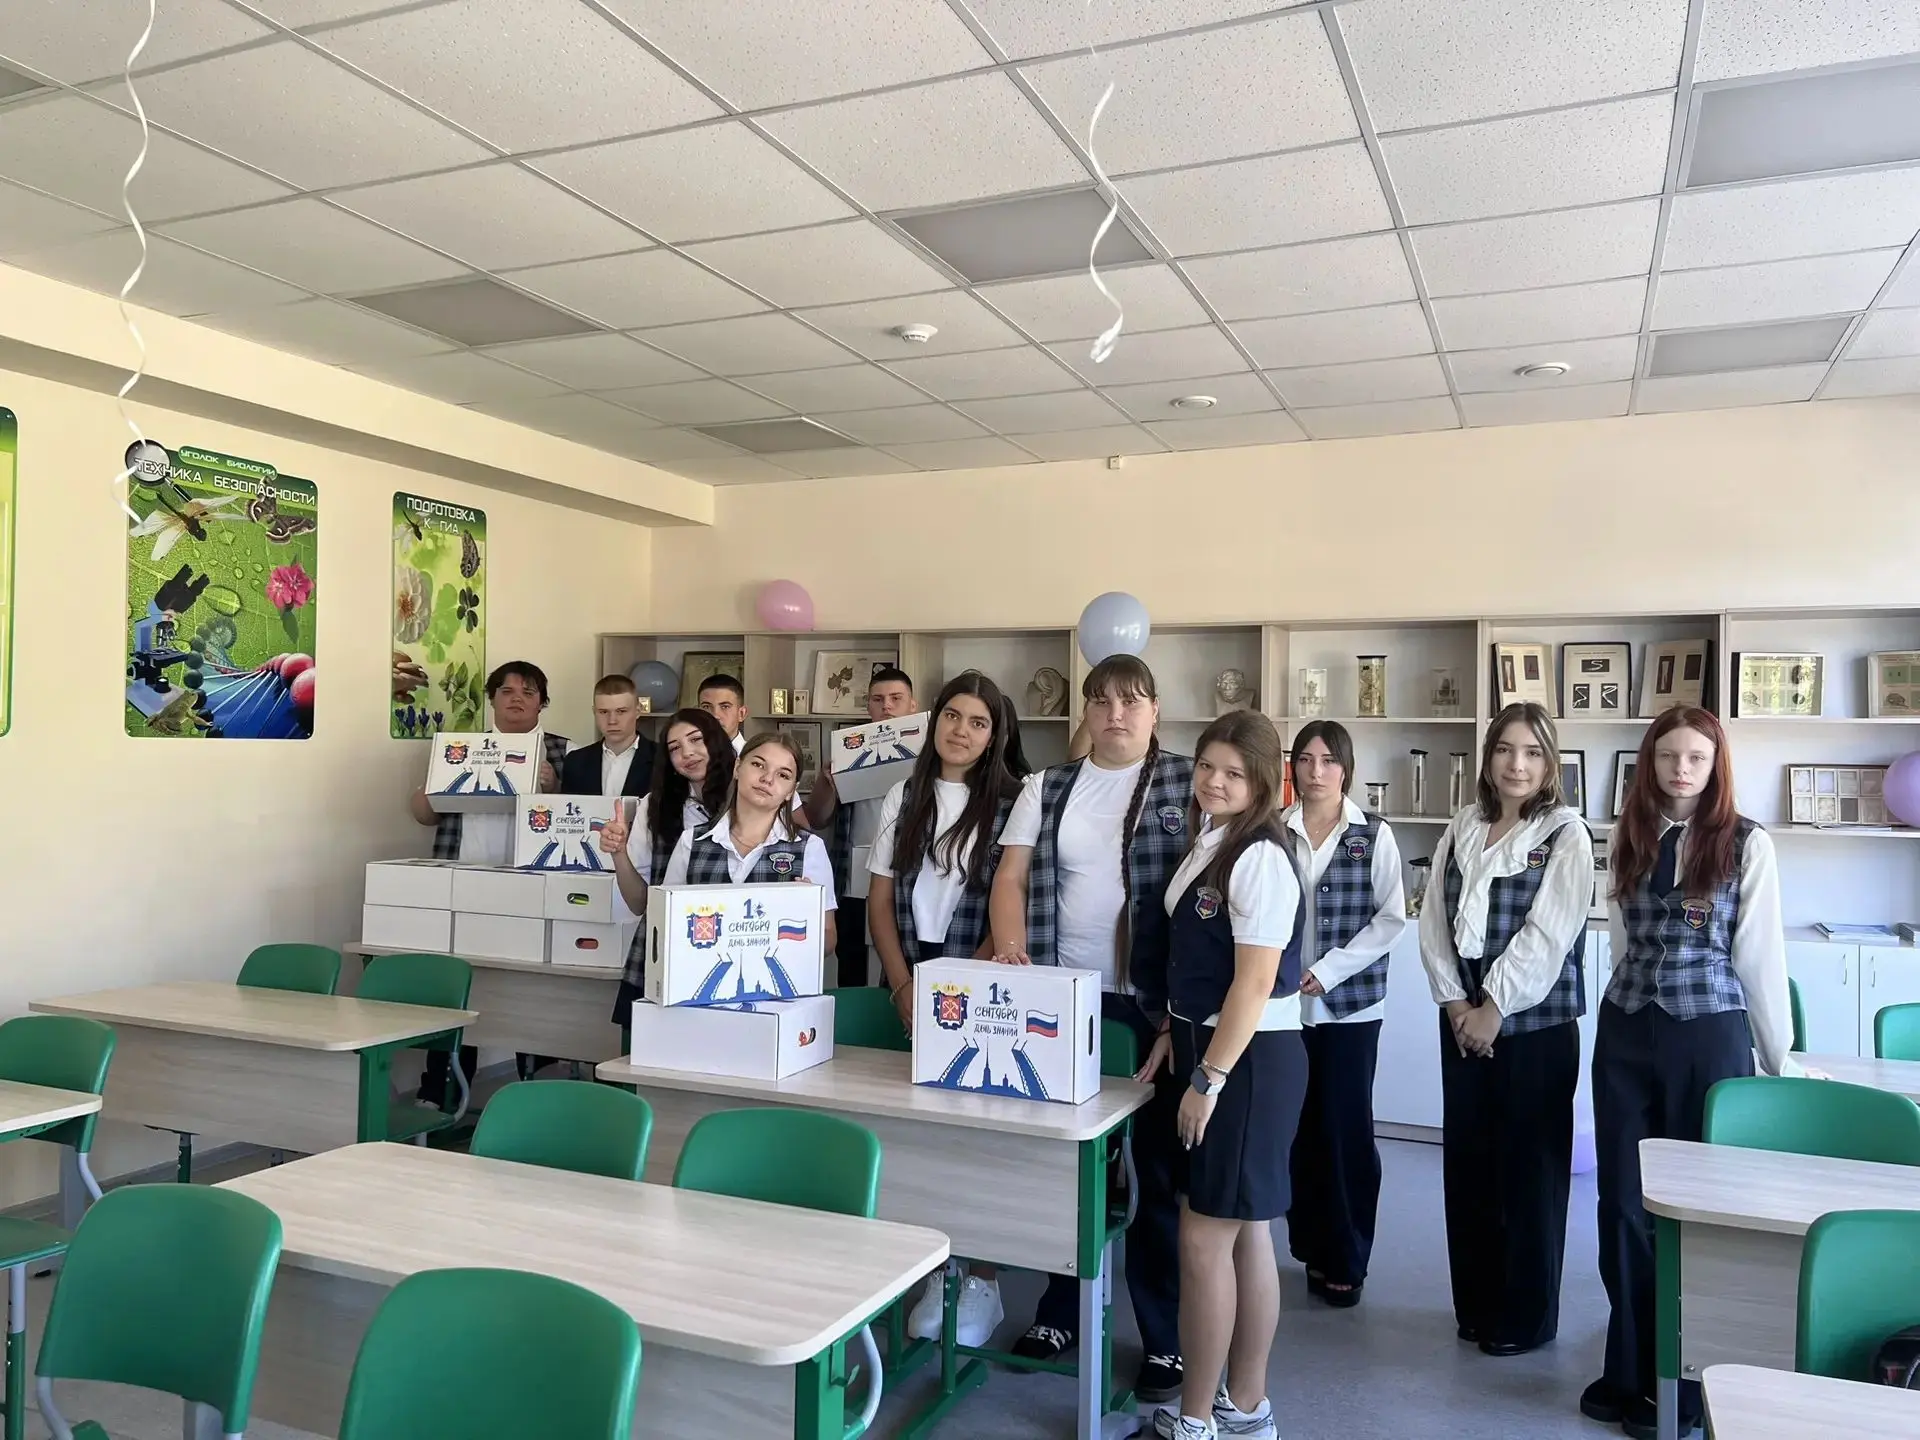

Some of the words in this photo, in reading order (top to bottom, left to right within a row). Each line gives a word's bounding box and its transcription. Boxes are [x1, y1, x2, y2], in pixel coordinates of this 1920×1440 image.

[180, 449, 219, 464] УГОЛОК
[226, 459, 276, 477] БИОЛОГИИ
[134, 458, 203, 485] ТЕХНИКА
[213, 475, 316, 506] БЕЗОПАСНОСТИ
[406, 496, 476, 523] ПОДГОТОВКА
[424, 517, 431, 529] К
[482, 738, 490, 750] 1
[565, 801, 574, 816] 1
[743, 898, 754, 919] 1
[728, 919, 771, 932] СЕНТЯБРЯ
[989, 982, 1001, 1005] 1
[974, 1006, 1018, 1022] СЕНТЯБРЯ
[973, 1023, 991, 1034] ДЕНЬ
